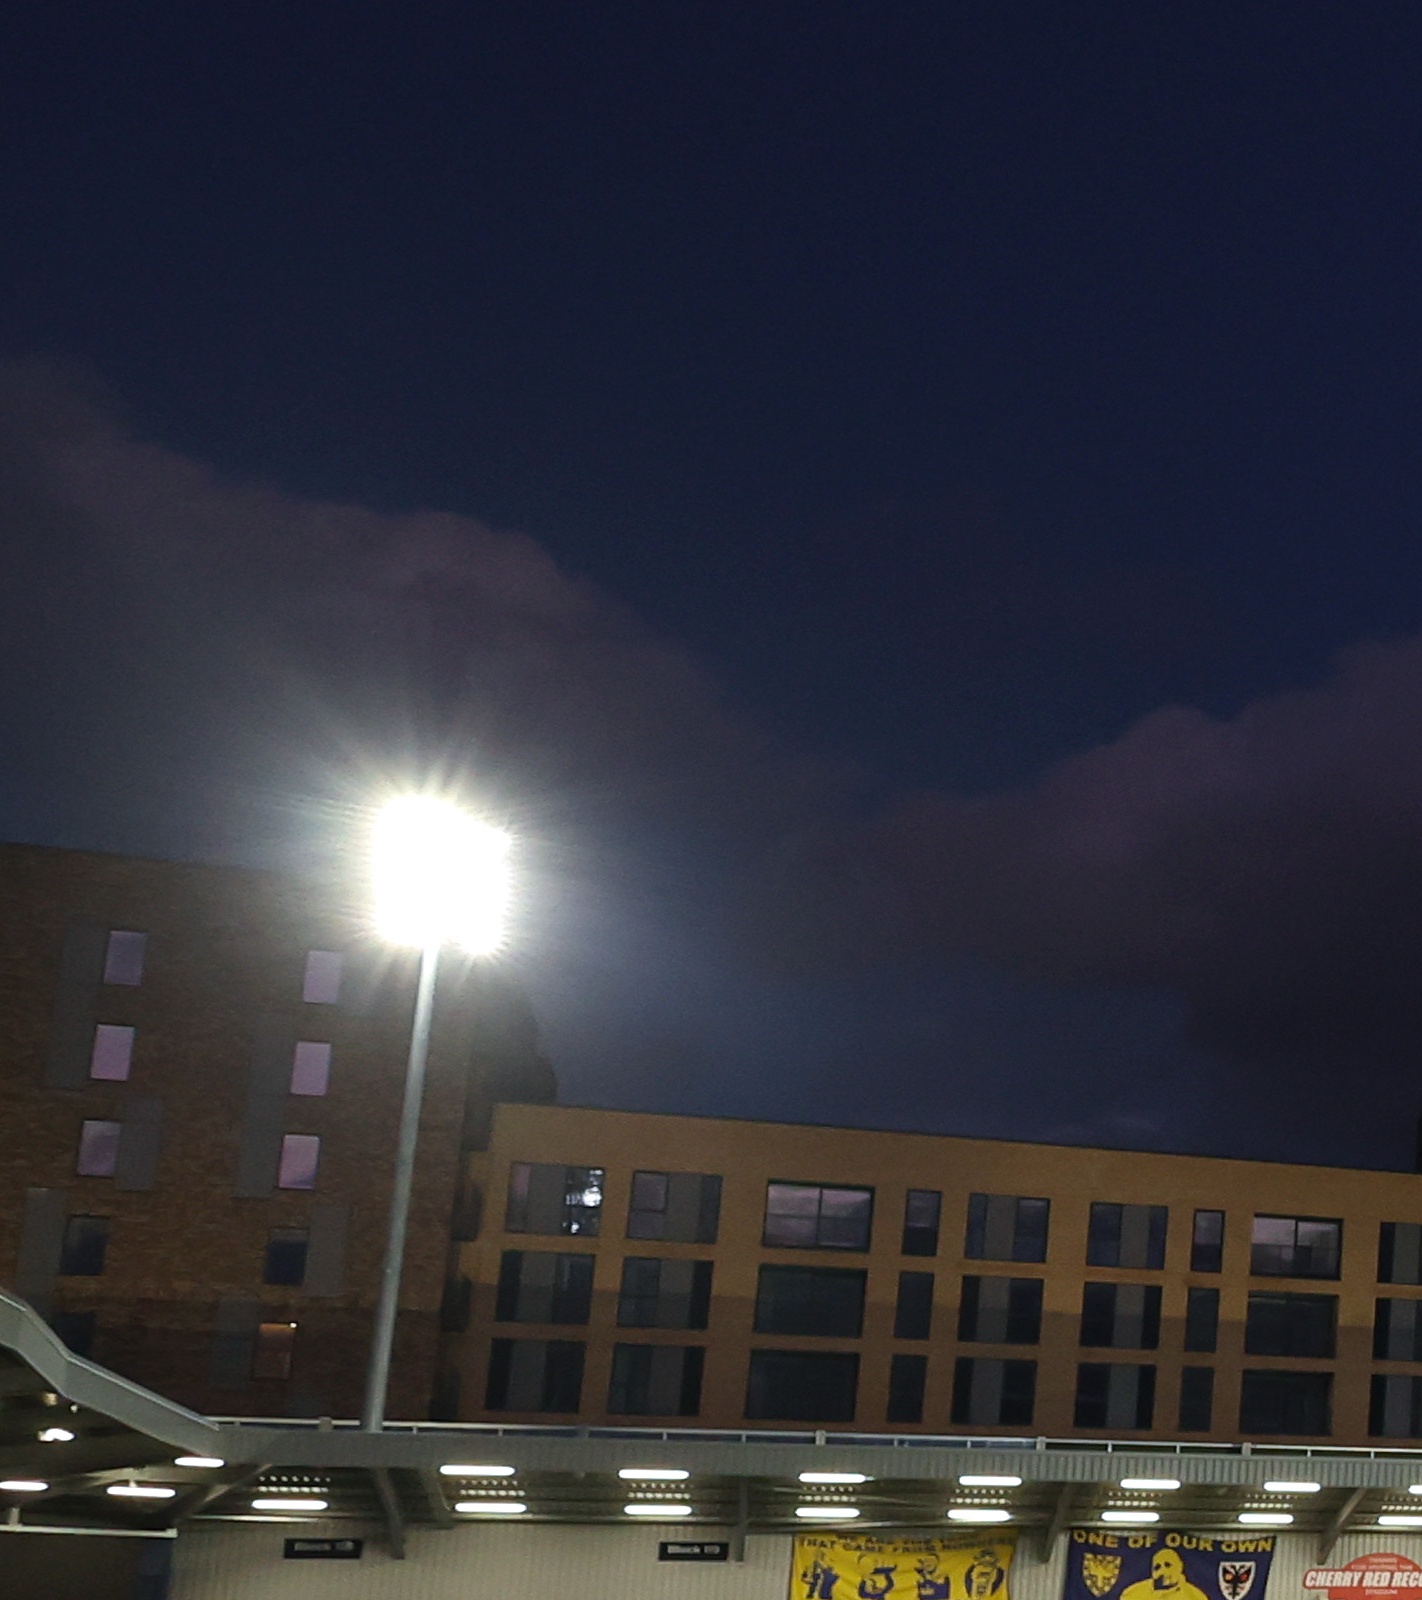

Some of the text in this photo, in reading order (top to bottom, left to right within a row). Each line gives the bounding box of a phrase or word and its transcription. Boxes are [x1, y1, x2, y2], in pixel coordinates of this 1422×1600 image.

[1073, 1529, 1273, 1553] ONE OF OUR OWN
[1305, 1570, 1364, 1587] CHERRY
[1361, 1571, 1392, 1587] RED
